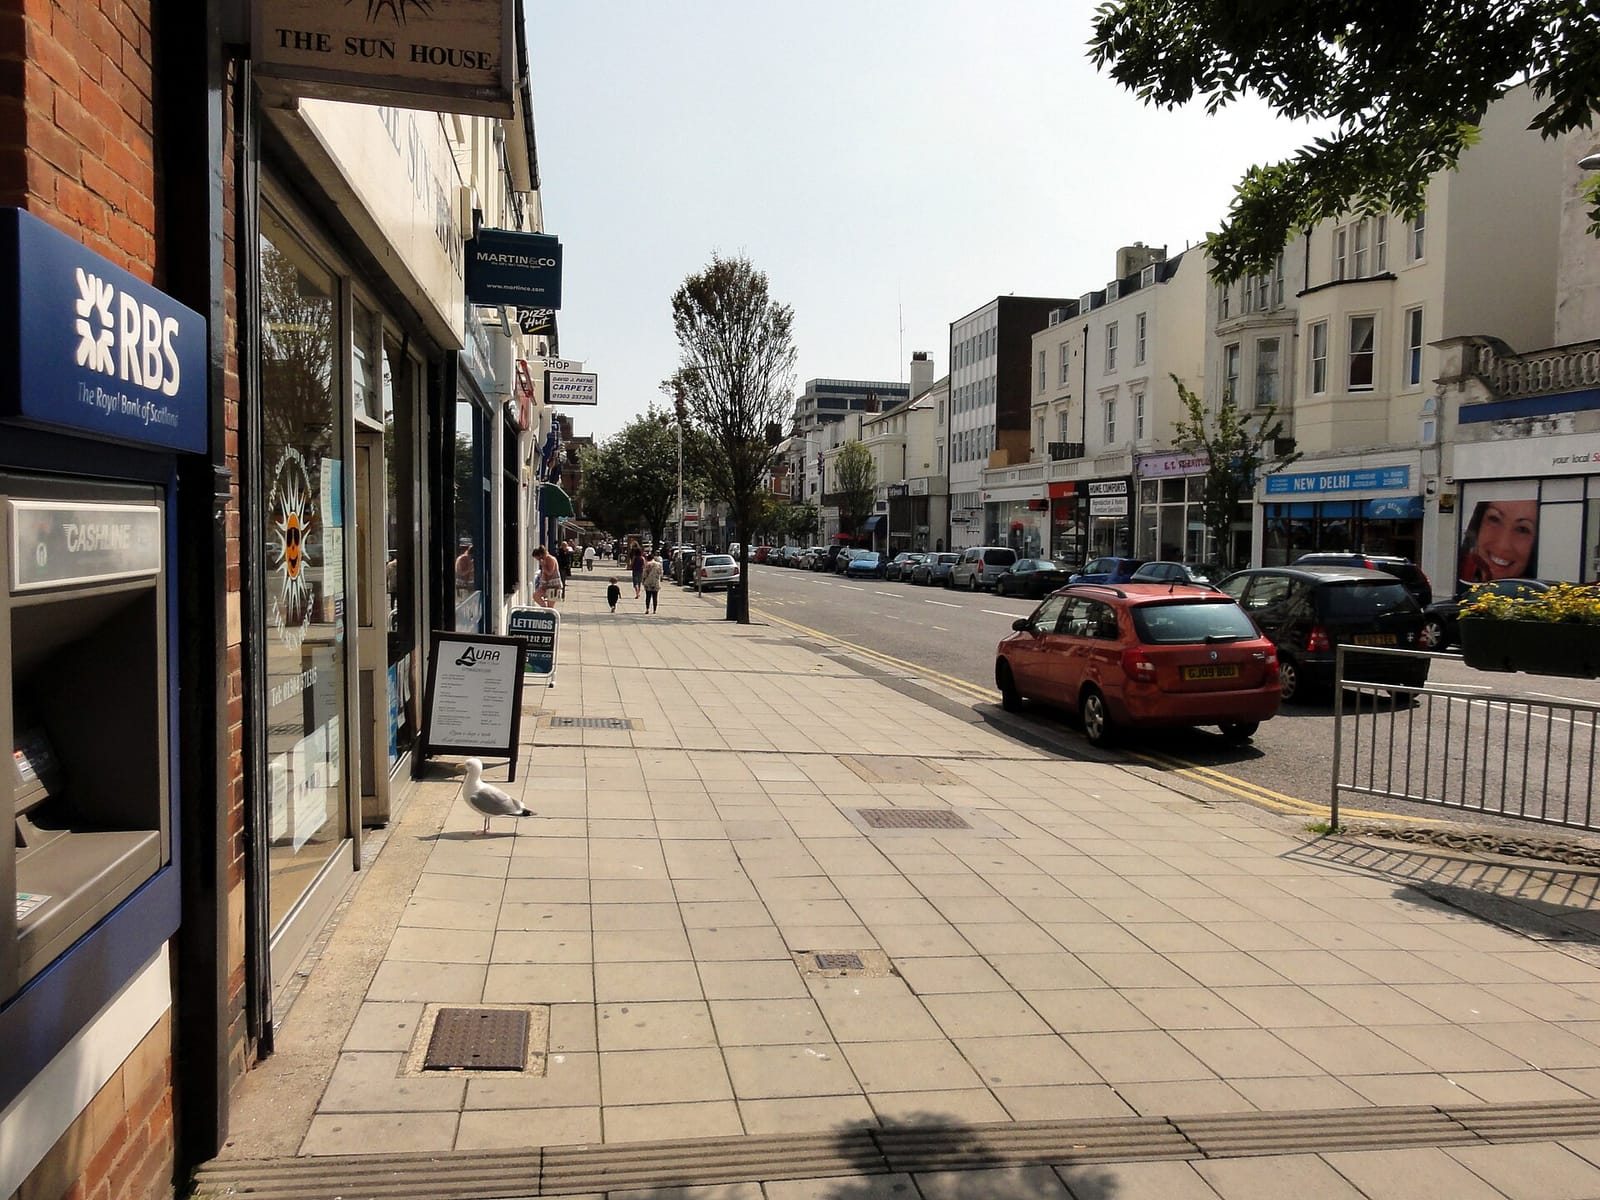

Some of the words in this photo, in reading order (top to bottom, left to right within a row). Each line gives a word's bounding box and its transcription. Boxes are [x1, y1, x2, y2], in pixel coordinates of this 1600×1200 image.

[275, 28, 331, 53] THE
[344, 37, 396, 60] SUN
[409, 44, 493, 71] HOUSE
[477, 252, 556, 267] MARTIN&CO
[525, 317, 551, 329] Hut
[119, 291, 180, 397] RBS
[552, 384, 593, 392] CARPETS
[79, 382, 94, 405] The
[96, 387, 120, 416] Royal
[122, 394, 140, 418] Bank
[141, 401, 150, 425] of
[1552, 456, 1569, 466] your
[1572, 452, 1590, 463] local
[1294, 477, 1316, 491] NEW
[1320, 474, 1350, 489] DELHI
[62, 523, 132, 552] CASHLINE
[513, 618, 553, 630] LETTINGS
